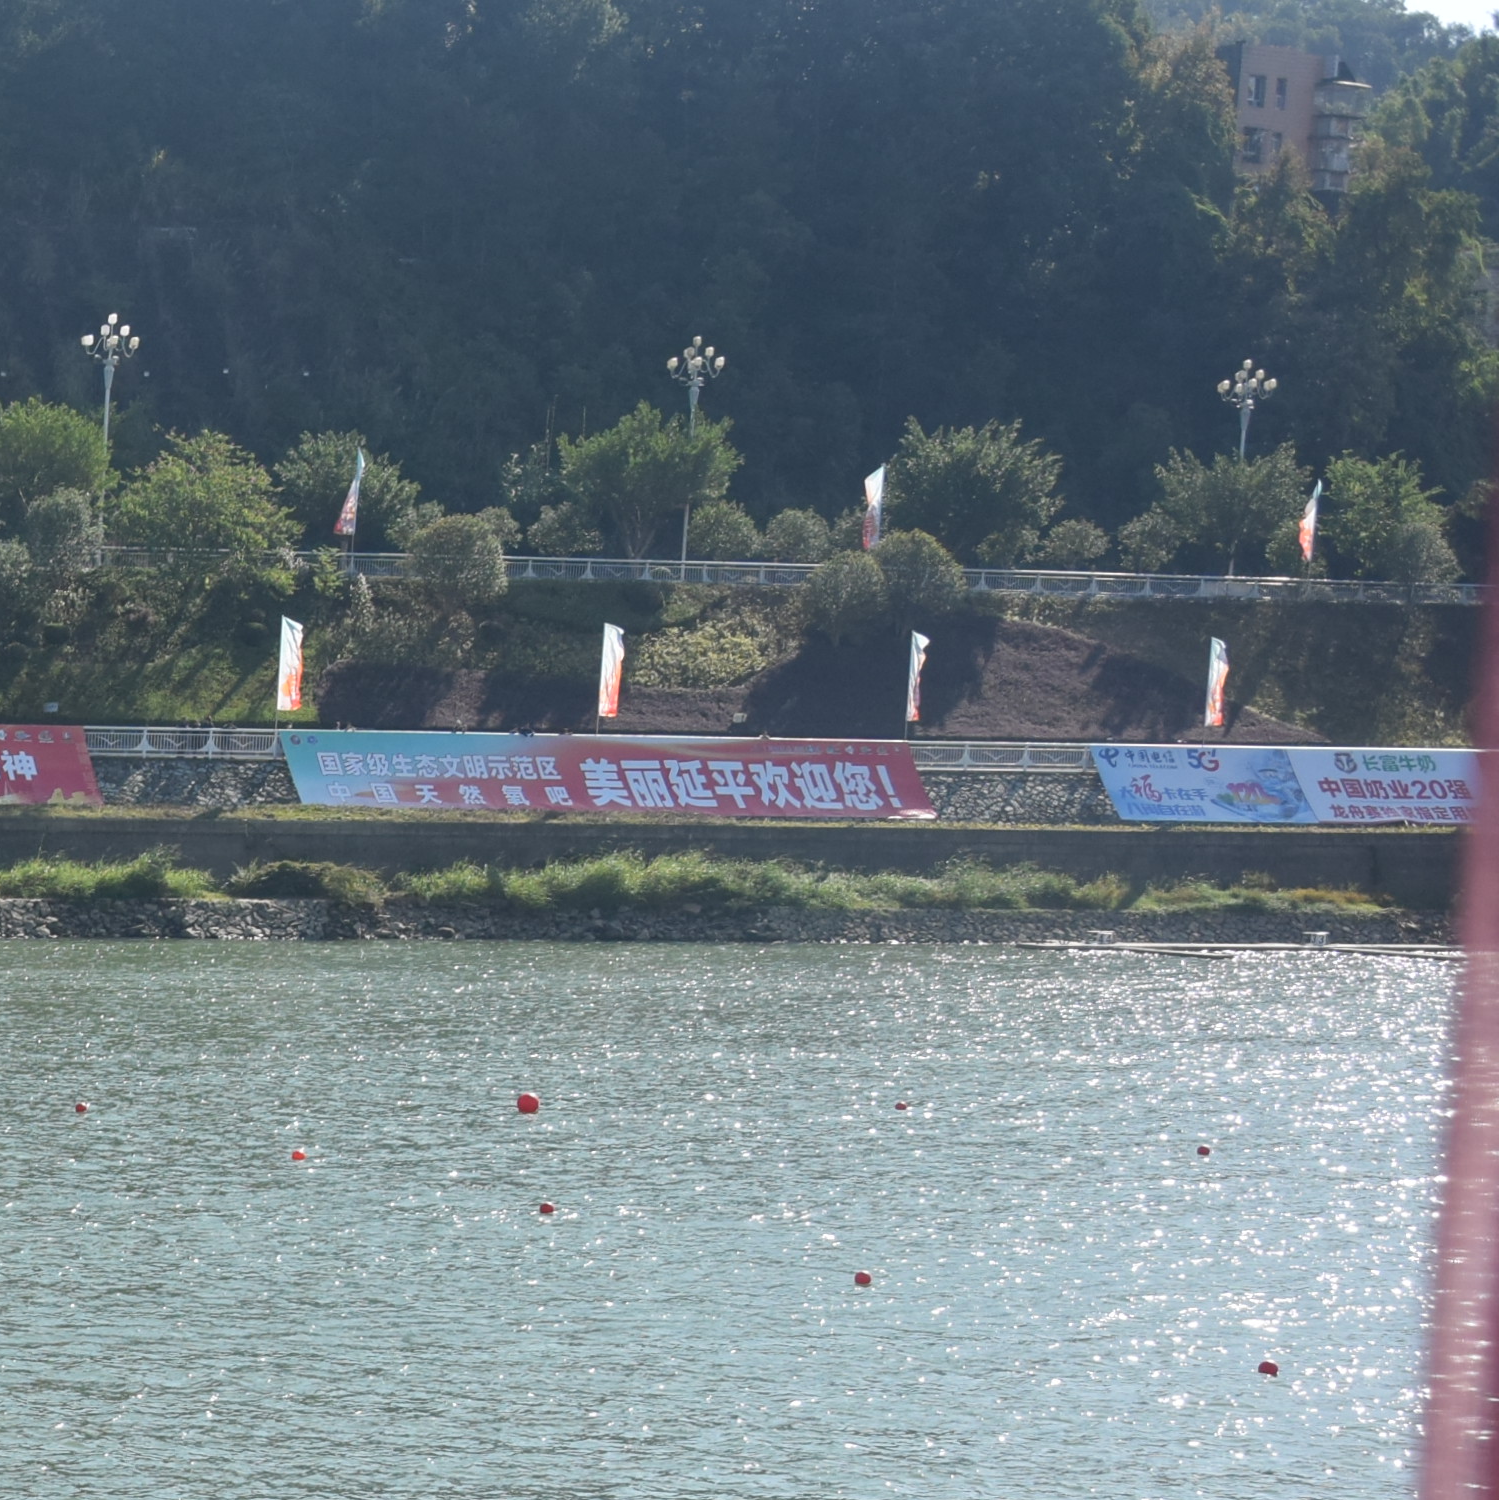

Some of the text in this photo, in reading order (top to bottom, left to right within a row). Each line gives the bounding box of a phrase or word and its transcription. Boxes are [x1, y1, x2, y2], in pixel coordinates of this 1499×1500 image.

[316, 751, 563, 780] 国家级生态文明示范区
[1124, 749, 1176, 763] 中国电信
[1362, 754, 1436, 773] 长富牛奶
[328, 782, 573, 807] 中国天然氧吧
[1317, 777, 1474, 800] 中国奶业20强
[1329, 804, 1479, 820] 龙舟赛独家指定用
